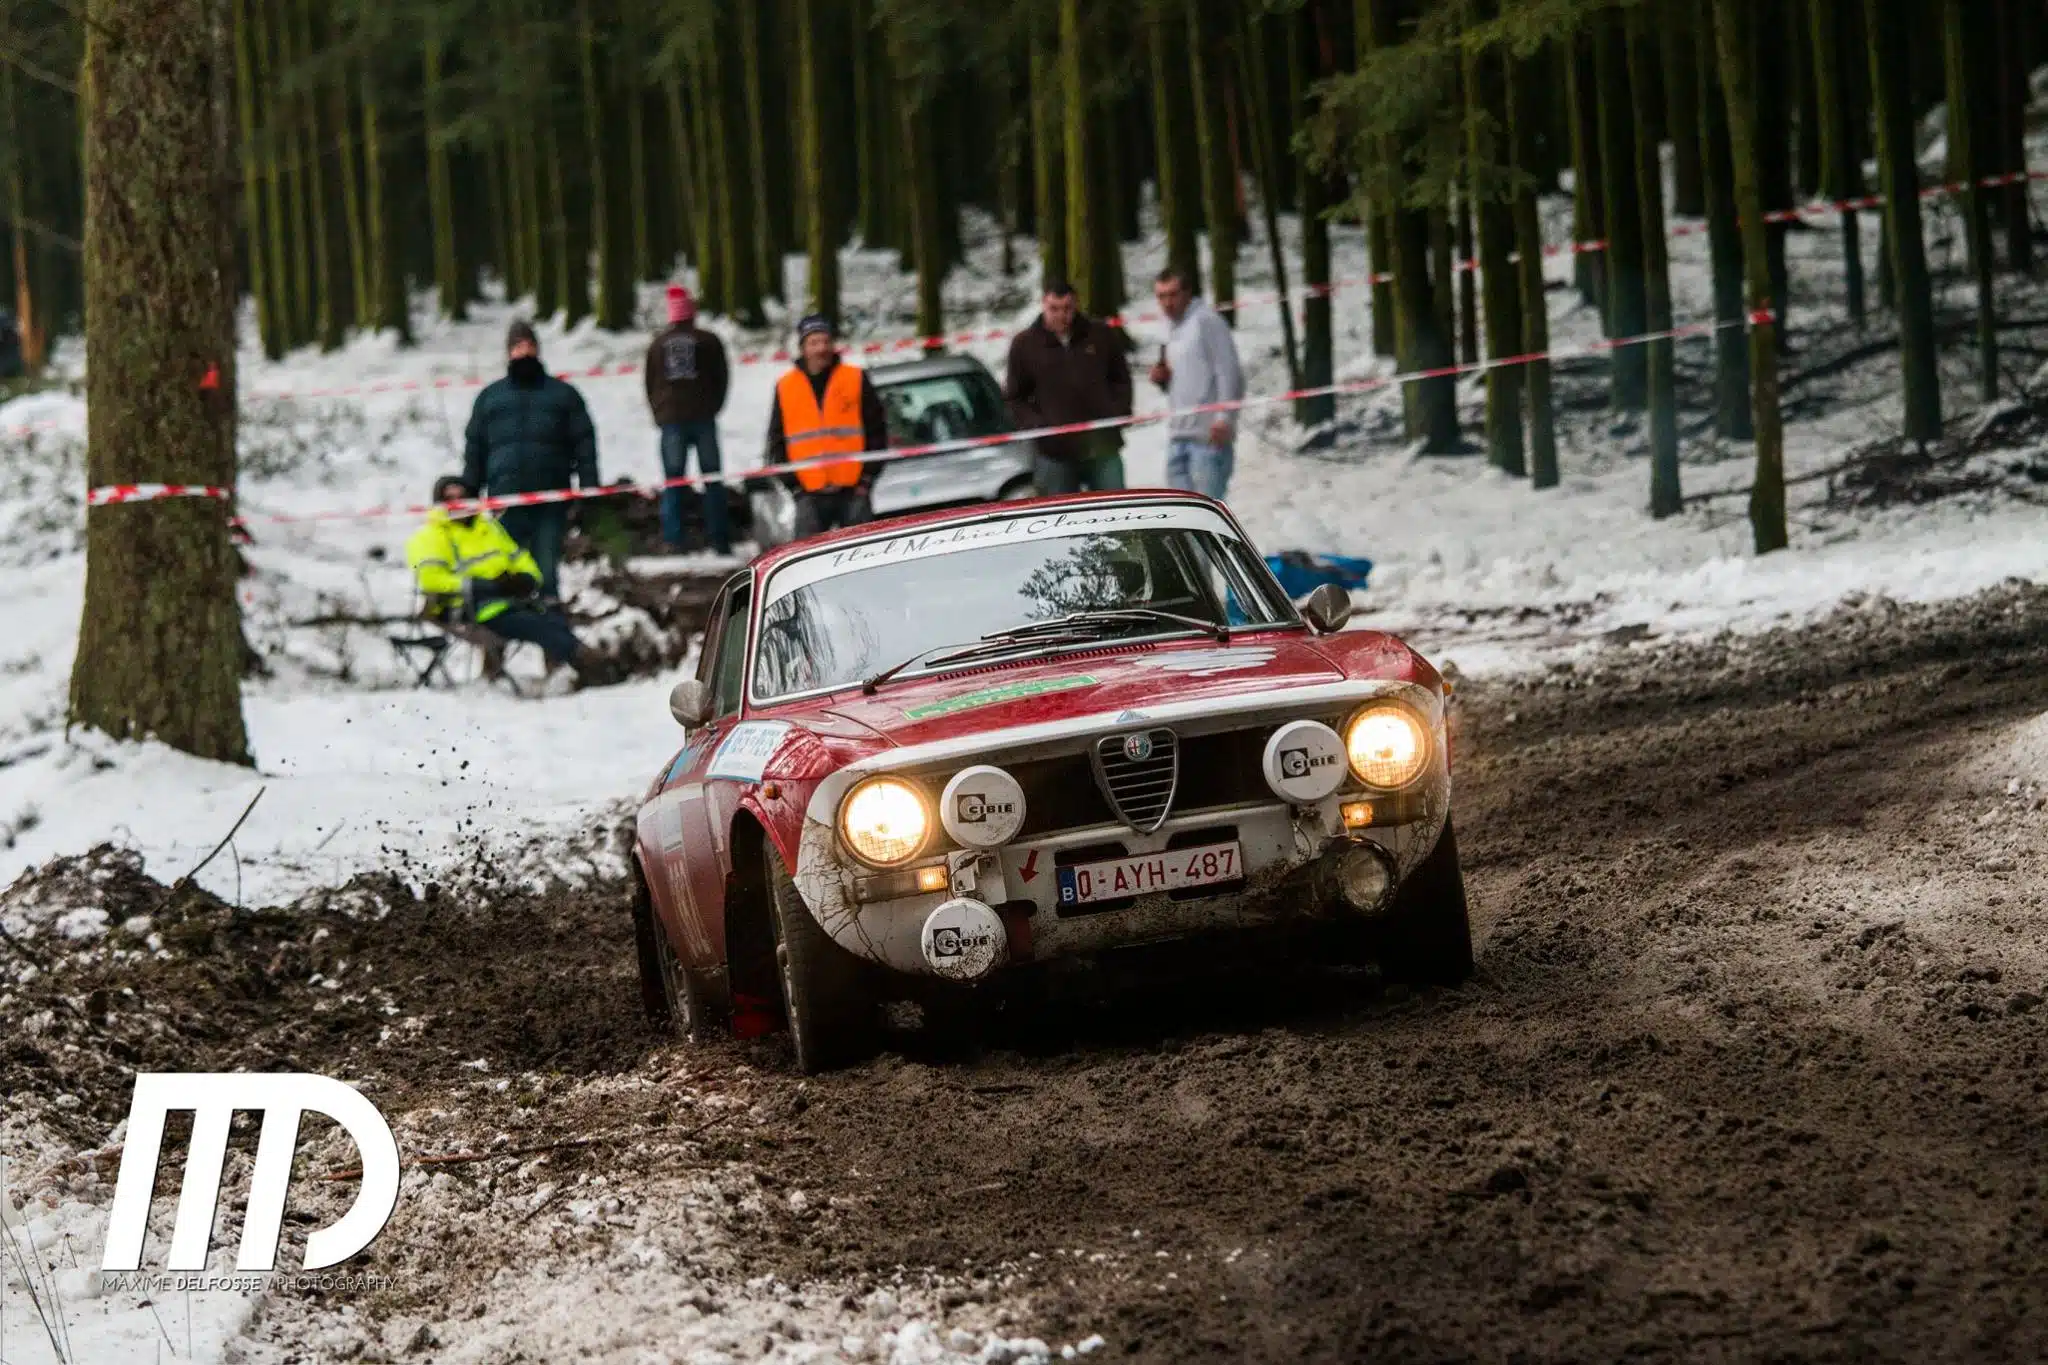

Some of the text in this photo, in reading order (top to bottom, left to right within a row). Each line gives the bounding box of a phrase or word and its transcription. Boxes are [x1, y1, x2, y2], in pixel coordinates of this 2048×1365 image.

[1027, 513, 1177, 534] Classics
[968, 803, 1014, 814] CIBIE
[1062, 886, 1075, 902] B
